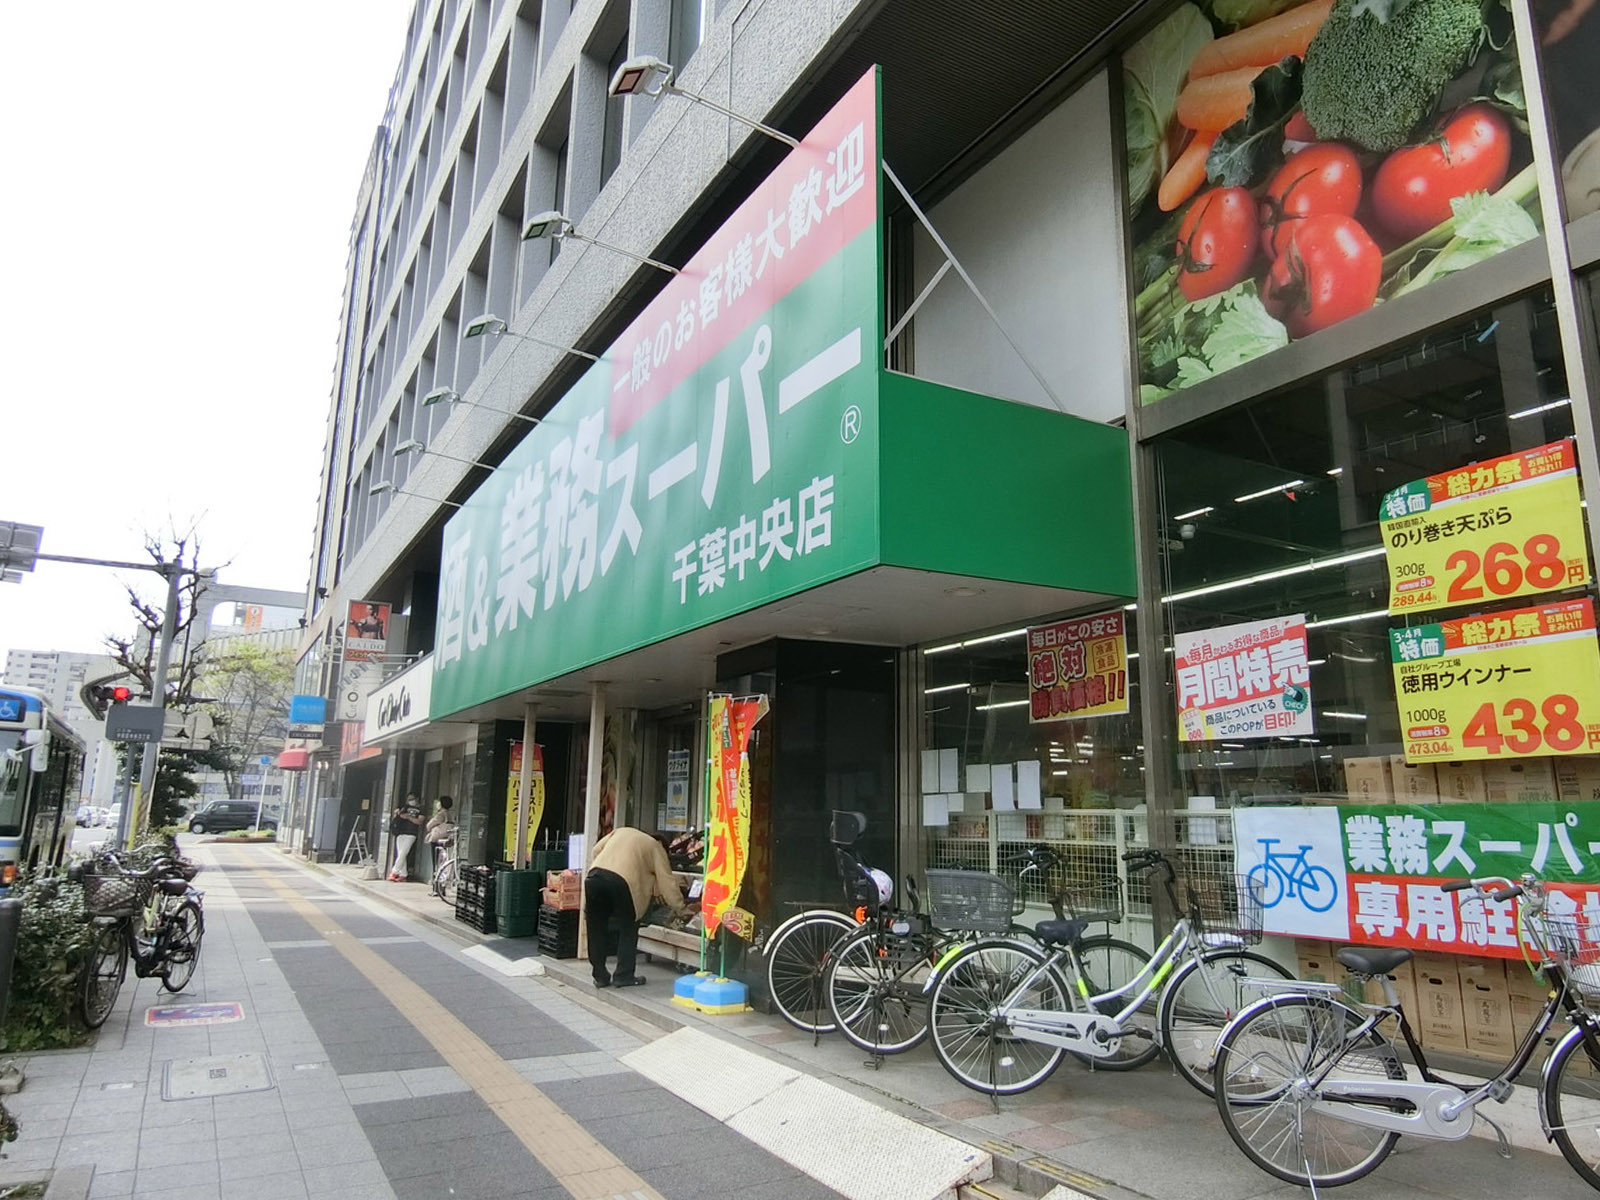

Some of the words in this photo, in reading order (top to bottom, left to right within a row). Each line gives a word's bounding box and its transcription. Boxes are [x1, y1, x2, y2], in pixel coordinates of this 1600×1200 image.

[613, 121, 865, 393] 一般のお客様大歓迎
[1446, 459, 1522, 497] 総力祭
[1387, 493, 1426, 518] 特価
[672, 476, 836, 605] 千葉中央店
[1391, 507, 1512, 549] のり巻き天ぷら
[1396, 563, 1425, 577] 300g
[1032, 617, 1118, 648] 毎日がこの安さ
[1461, 612, 1541, 645] 総力祭
[1399, 637, 1439, 661] 特価
[1031, 640, 1086, 690] 絶対
[1177, 637, 1309, 710] 月間特売
[1400, 659, 1461, 674] 自社グループ工場
[1401, 664, 1532, 694] 徳用ウインナー
[1206, 699, 1277, 726] 商品についている
[1284, 701, 1304, 711] CHECK
[1407, 708, 1446, 723] 1000g
[1345, 813, 1600, 874] 業務スーパ
